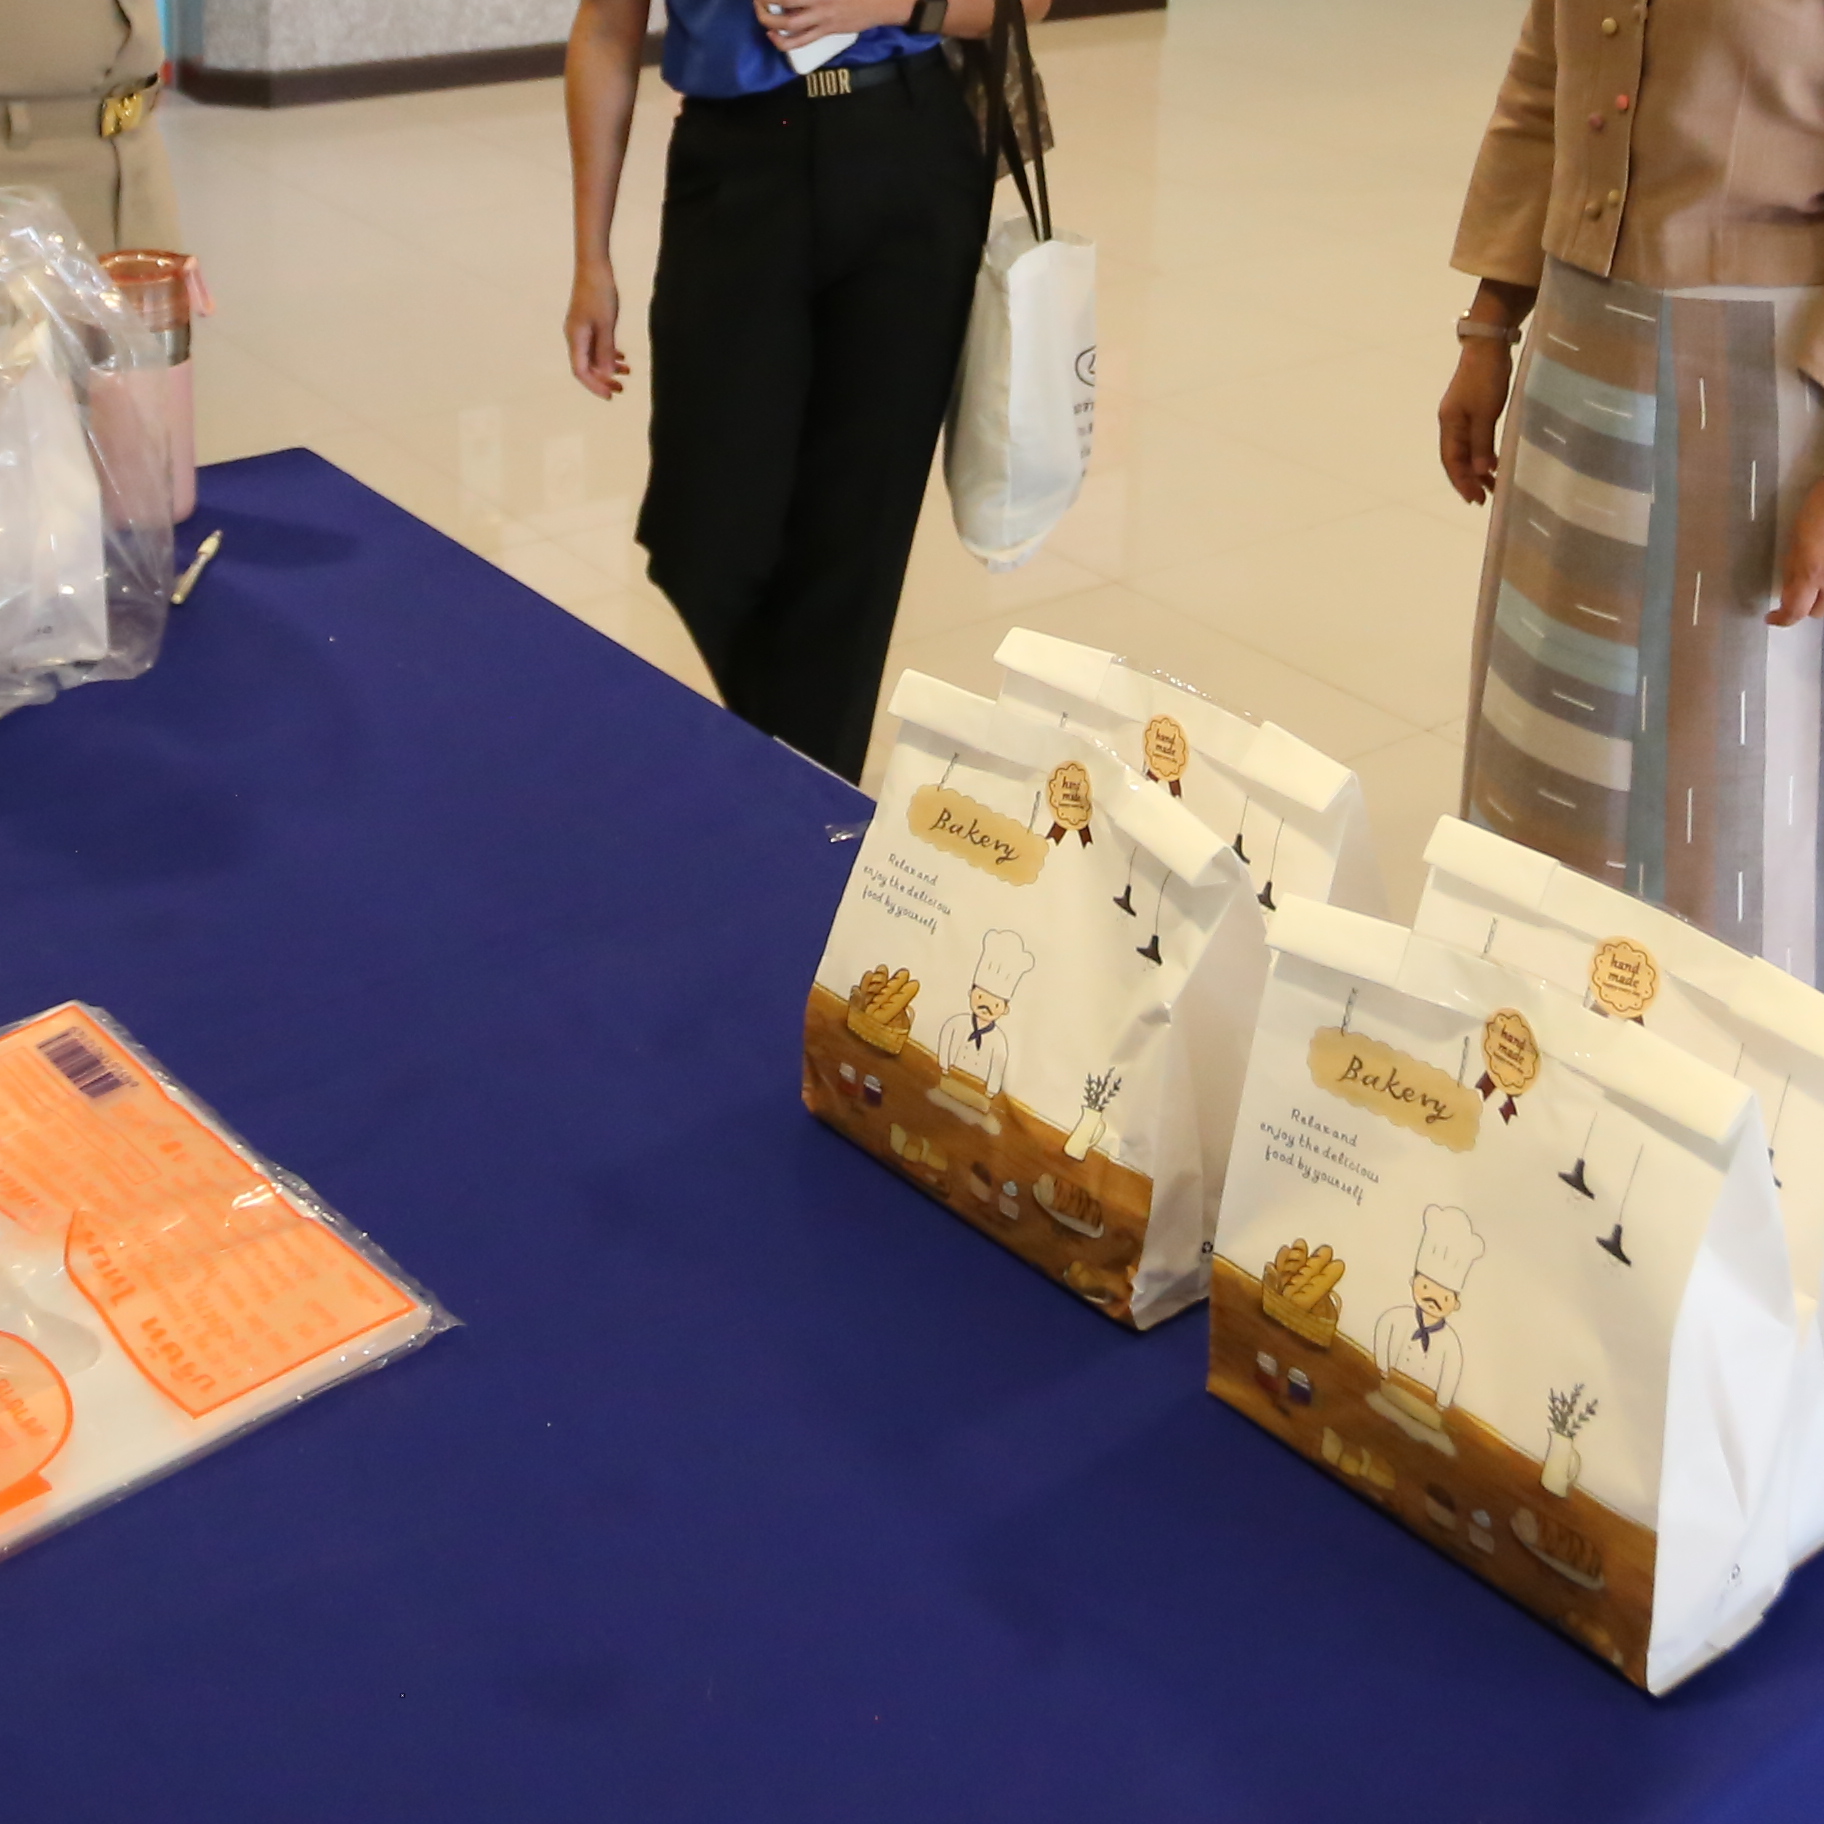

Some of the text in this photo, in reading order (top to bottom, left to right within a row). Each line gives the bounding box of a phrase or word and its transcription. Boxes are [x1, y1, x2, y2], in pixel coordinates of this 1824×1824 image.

[806, 68, 852, 98] DIOR
[929, 807, 1020, 865] Bakery
[1611, 953, 1641, 975] hand
[1607, 972, 1640, 988] made
[1500, 1024, 1527, 1051] hand
[1336, 1054, 1454, 1125] Bakery
[1259, 1121, 1380, 1184] enjoy the delicious
[1332, 1130, 1359, 1147] and
[1264, 1144, 1365, 1207] food by yourself
